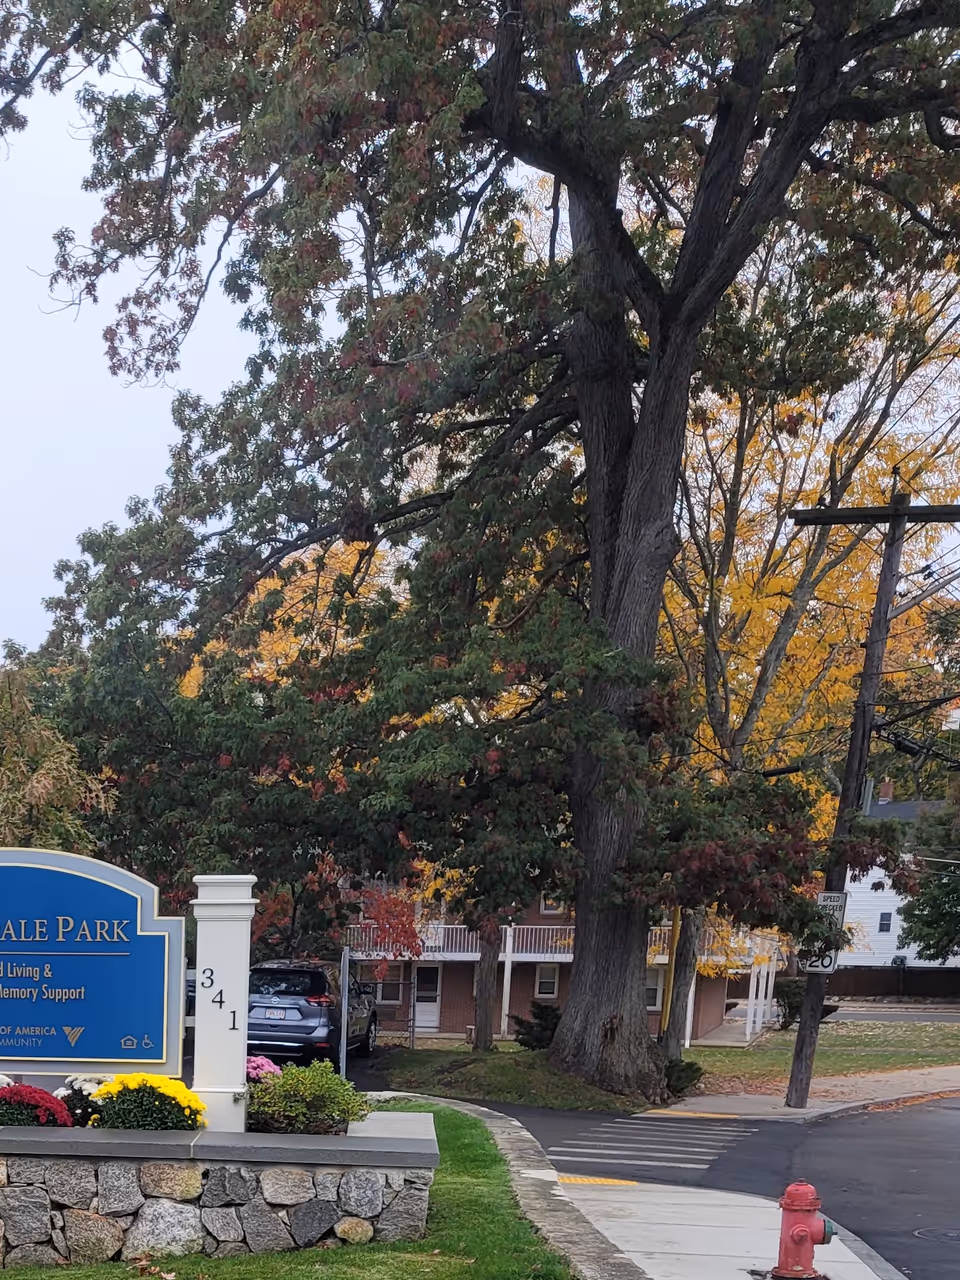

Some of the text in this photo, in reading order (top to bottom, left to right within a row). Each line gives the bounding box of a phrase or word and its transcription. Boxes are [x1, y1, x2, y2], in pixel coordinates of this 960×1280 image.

[56, 916, 130, 943] PARK
[8, 963, 40, 980] Living
[44, 964, 52, 978] &
[41, 984, 85, 1003] Support
[0, 1026, 13, 1035] OF
[16, 1026, 56, 1036] AMERICA
